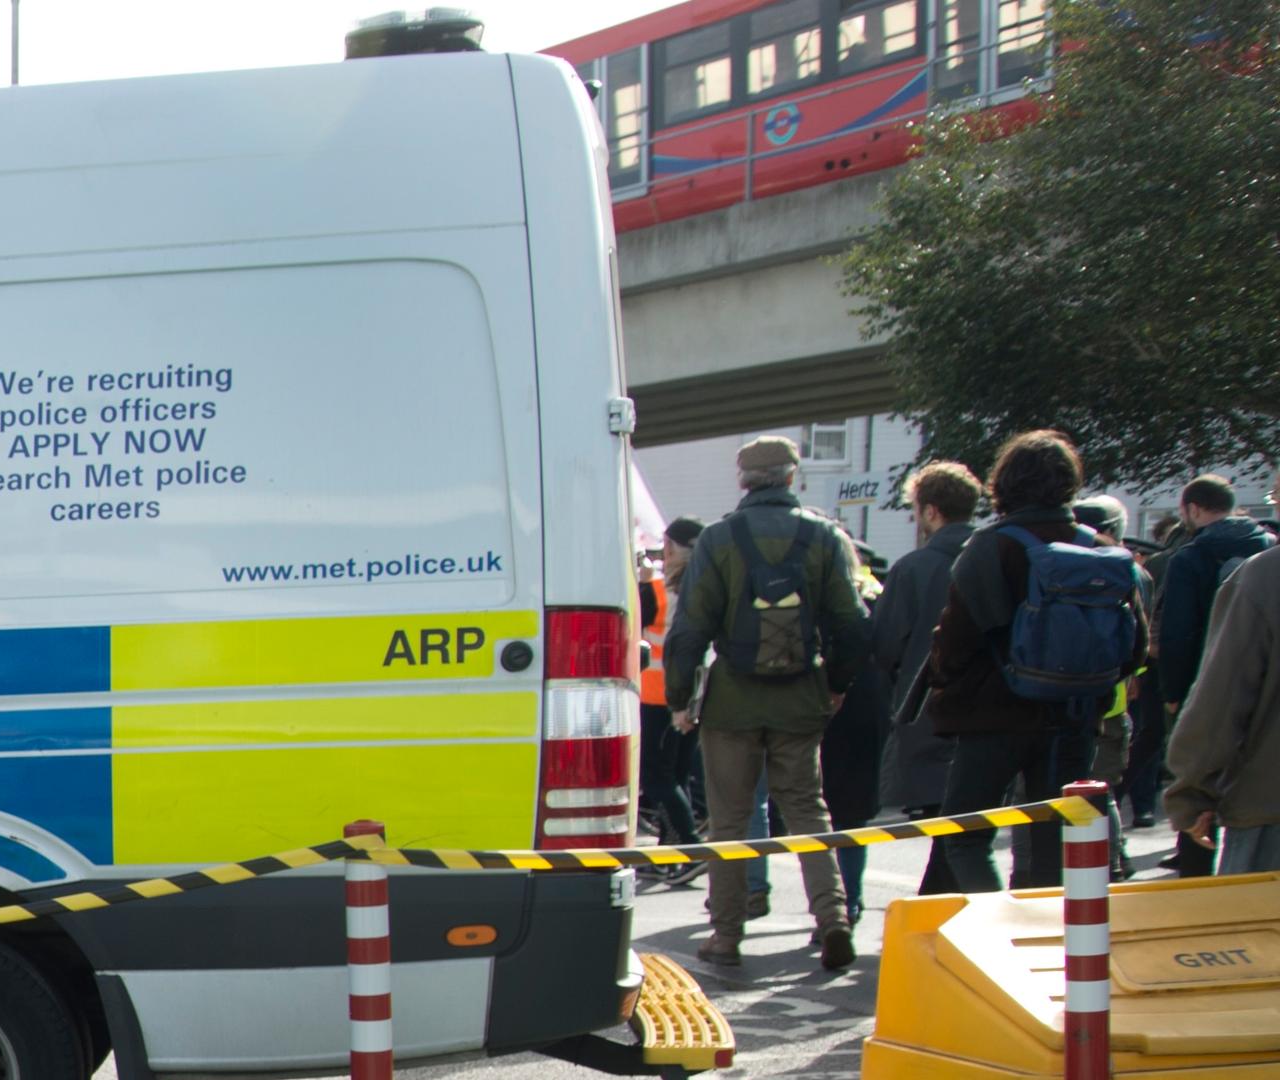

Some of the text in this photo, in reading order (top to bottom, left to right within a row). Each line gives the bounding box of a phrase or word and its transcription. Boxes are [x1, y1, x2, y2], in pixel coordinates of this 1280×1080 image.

[87, 363, 233, 393] recruiting
[0, 397, 217, 433] police officers
[7, 427, 207, 459] APPLY NOW
[85, 463, 144, 488] Met
[156, 459, 247, 492] police
[839, 480, 880, 499] Hertz
[50, 500, 160, 521] careers
[222, 550, 503, 583] www.met.police.uk
[382, 626, 486, 667] ARP
[1174, 949, 1252, 967] GRIT
